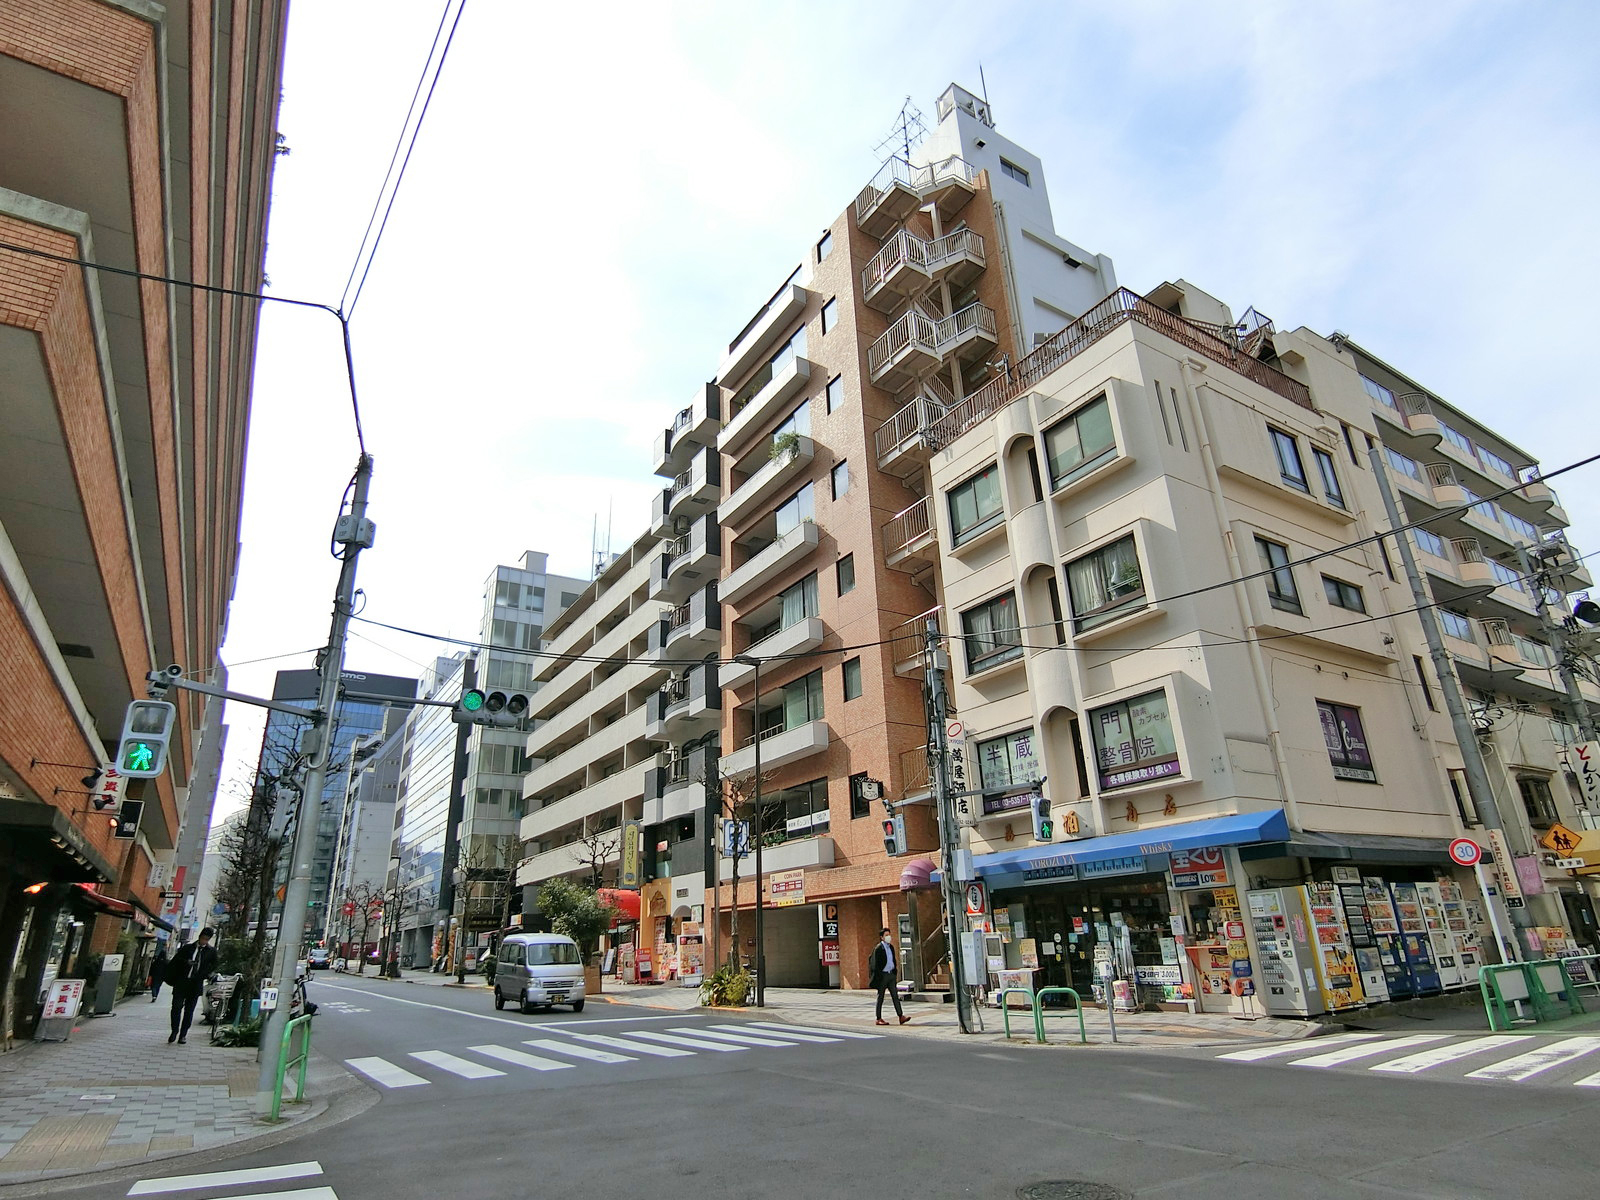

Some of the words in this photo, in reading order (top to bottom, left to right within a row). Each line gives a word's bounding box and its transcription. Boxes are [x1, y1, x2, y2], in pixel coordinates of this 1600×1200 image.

[1138, 712, 1167, 725] カプセル
[1099, 736, 1156, 767] 整骨院
[1109, 764, 1172, 785] 各種保険取り扱い
[991, 801, 1001, 809] TEL
[1002, 793, 1037, 807] 03-5357-19
[1139, 841, 1174, 856] Whisky
[1456, 845, 1474, 858] 30
[1029, 854, 1076, 870] YOROZUYA
[1171, 847, 1220, 868] 宝くじ
[827, 905, 837, 919] P
[826, 922, 838, 936] 空
